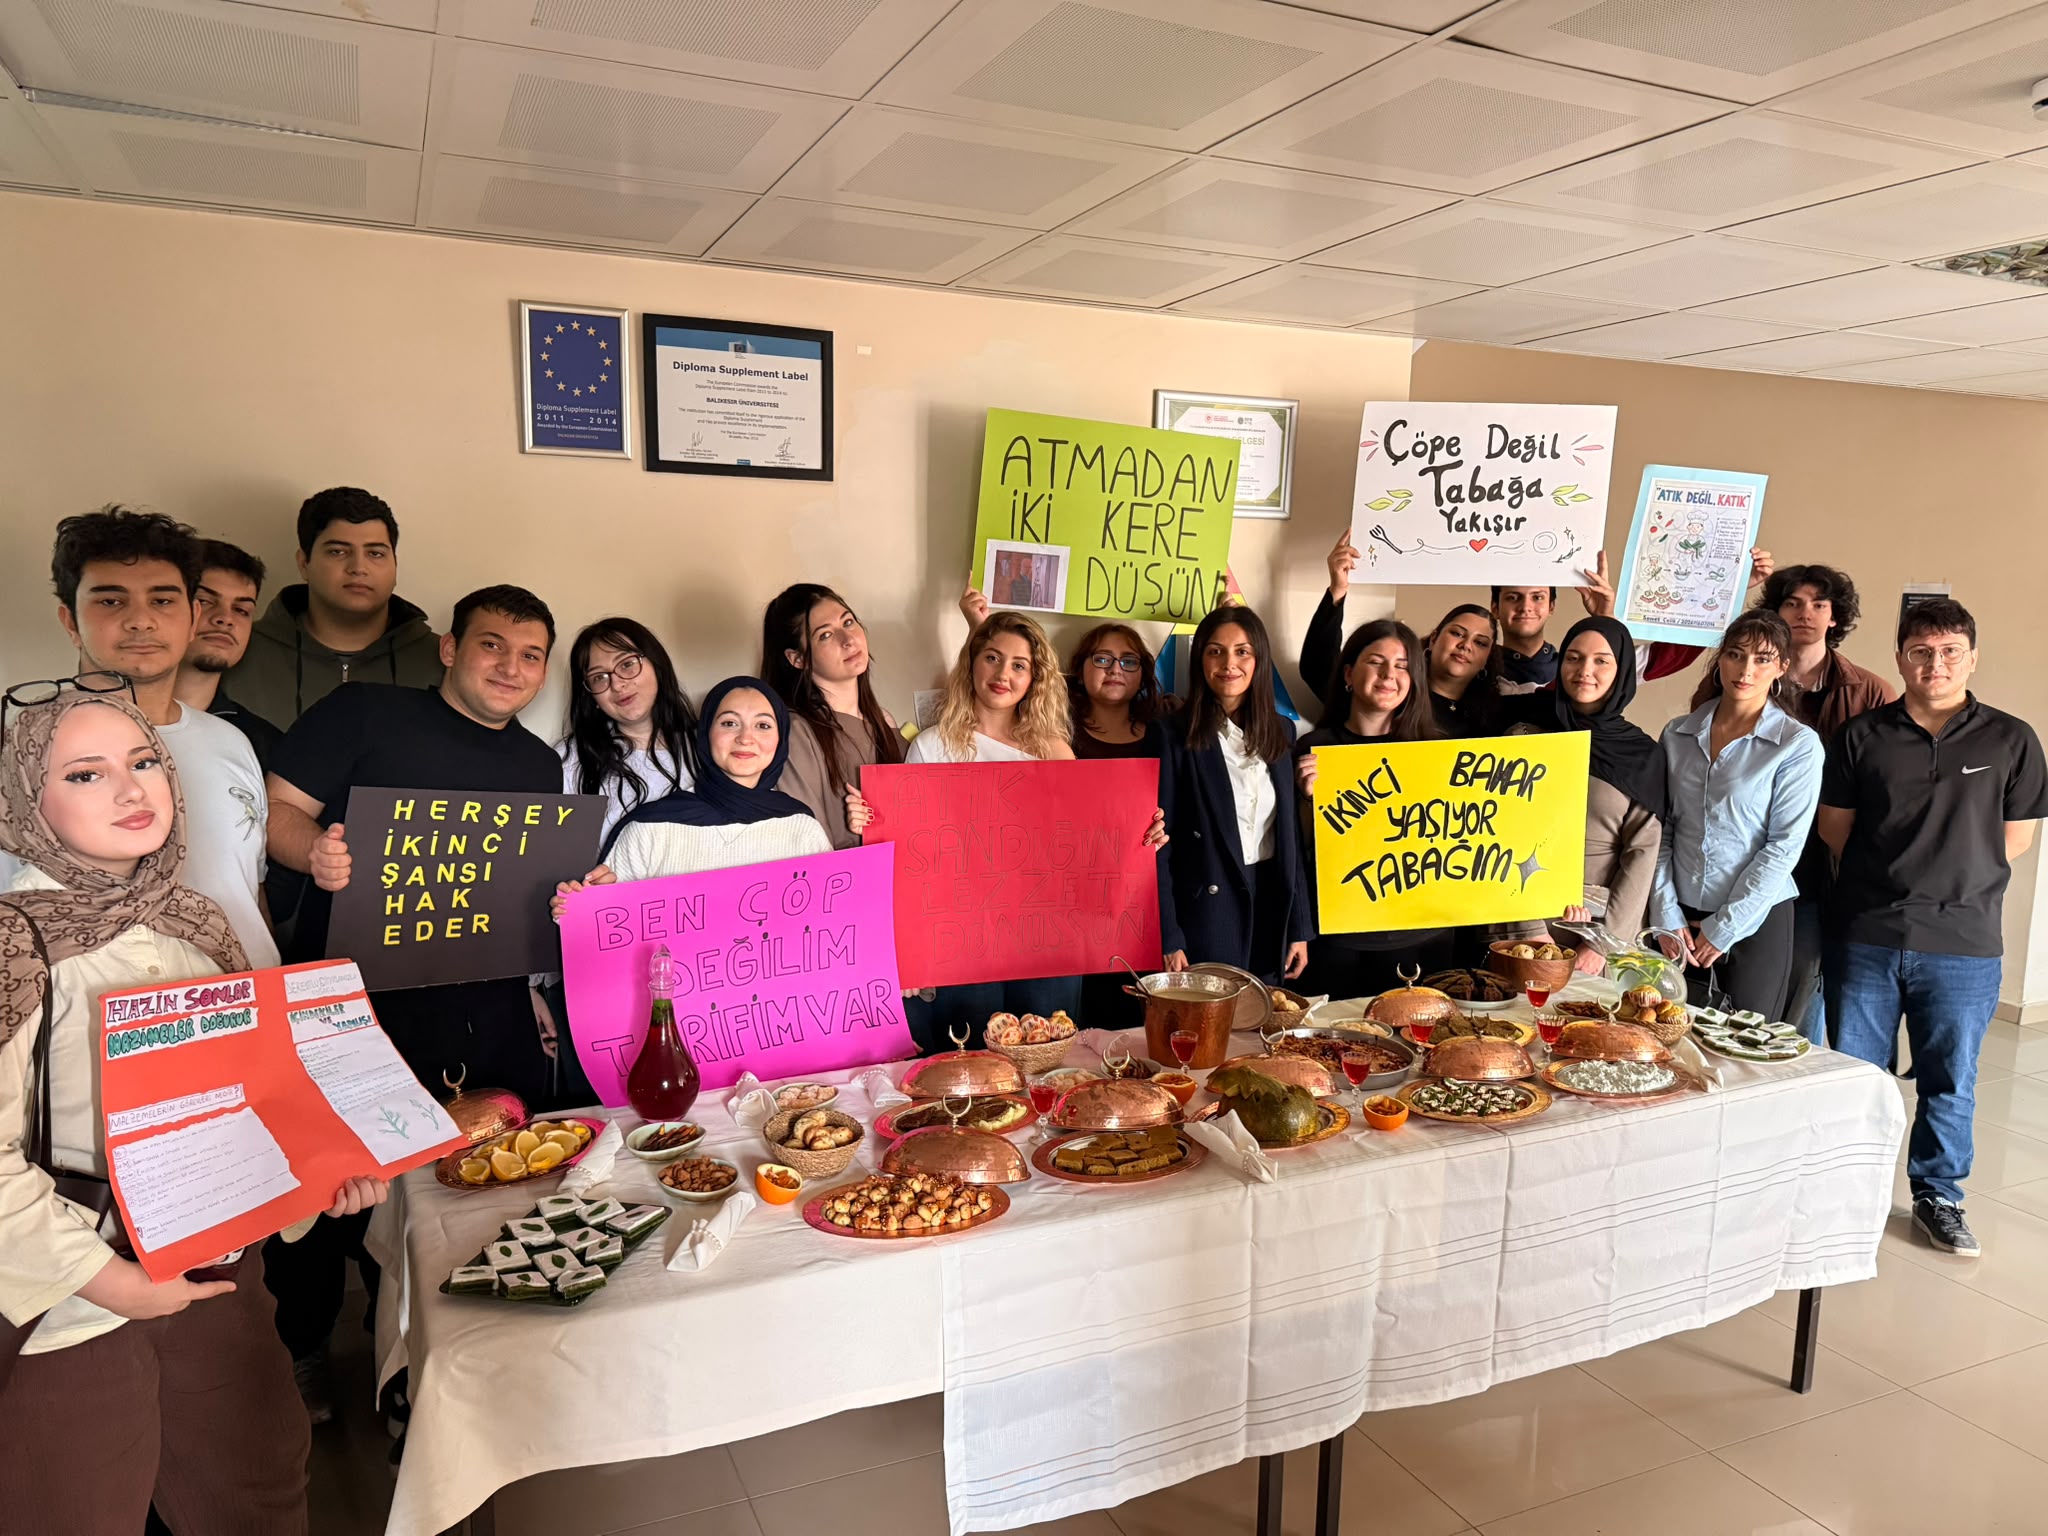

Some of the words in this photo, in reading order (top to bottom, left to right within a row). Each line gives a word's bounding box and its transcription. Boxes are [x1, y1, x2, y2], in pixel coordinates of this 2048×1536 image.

[672, 361, 716, 376] Diploma
[718, 365, 780, 379] Supplement
[782, 371, 809, 381] Label
[536, 403, 562, 412] Diploma
[563, 405, 600, 414] Supplement
[536, 413, 564, 422] 2011
[589, 417, 617, 425] 2014
[1384, 419, 1462, 466] Çöpe
[1485, 424, 1561, 463] Değil
[1001, 436, 1233, 503] ATMADAN
[1418, 460, 1544, 510] Tabağa
[1011, 488, 1053, 544] İKİ
[1439, 506, 1527, 536] Yakışır
[1686, 490, 1716, 506] DEĞİL,
[1101, 500, 1204, 562] KERE
[1086, 556, 1220, 620] DÜŞÜN
[394, 800, 574, 828] HERŞEY
[894, 768, 1026, 825] ATIK
[1318, 758, 1402, 835] İKİNCİ
[384, 828, 528, 856] İKİNCİ
[1384, 798, 1498, 844] YAŞIYOR
[904, 820, 1120, 877] SANDIĞIN
[1341, 839, 1513, 902] TABAĞIM
[380, 862, 492, 889] ŞANSI
[384, 888, 472, 916] HAK
[594, 894, 706, 952] BEN
[738, 870, 853, 927] ÇÖP
[384, 914, 490, 946] EDER
[671, 924, 856, 999] DEĞİLİM
[107, 992, 178, 1023] HAZİN
[184, 980, 250, 1010] SONLAR
[200, 1008, 252, 1034] DOĞURUR
[592, 993, 805, 1078] TRİFİM
[110, 1104, 176, 1128] MALZEMELERİN
